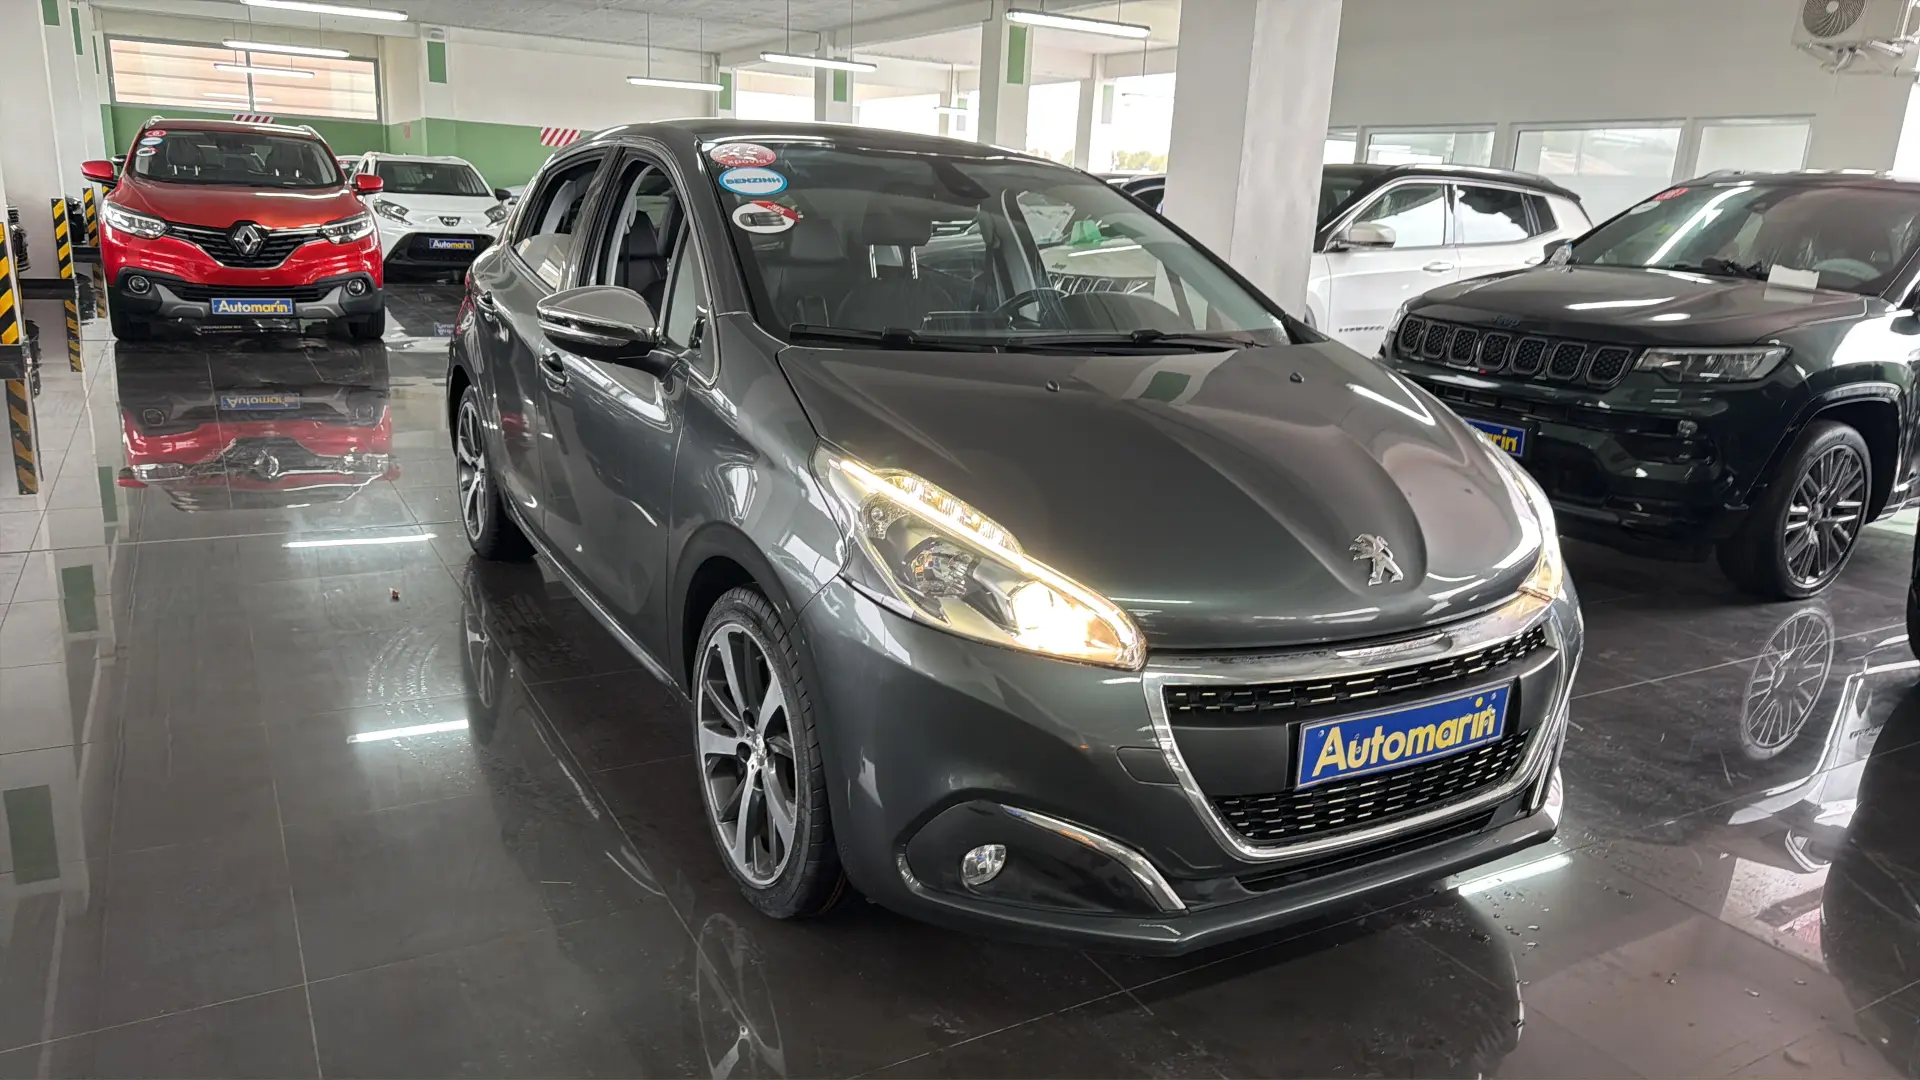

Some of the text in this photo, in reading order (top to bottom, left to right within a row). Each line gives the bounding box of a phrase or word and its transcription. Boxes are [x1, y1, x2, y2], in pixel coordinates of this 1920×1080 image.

[433, 239, 472, 249] Automarin
[218, 300, 288, 313] Automarin
[1311, 696, 1496, 777] Automarin
